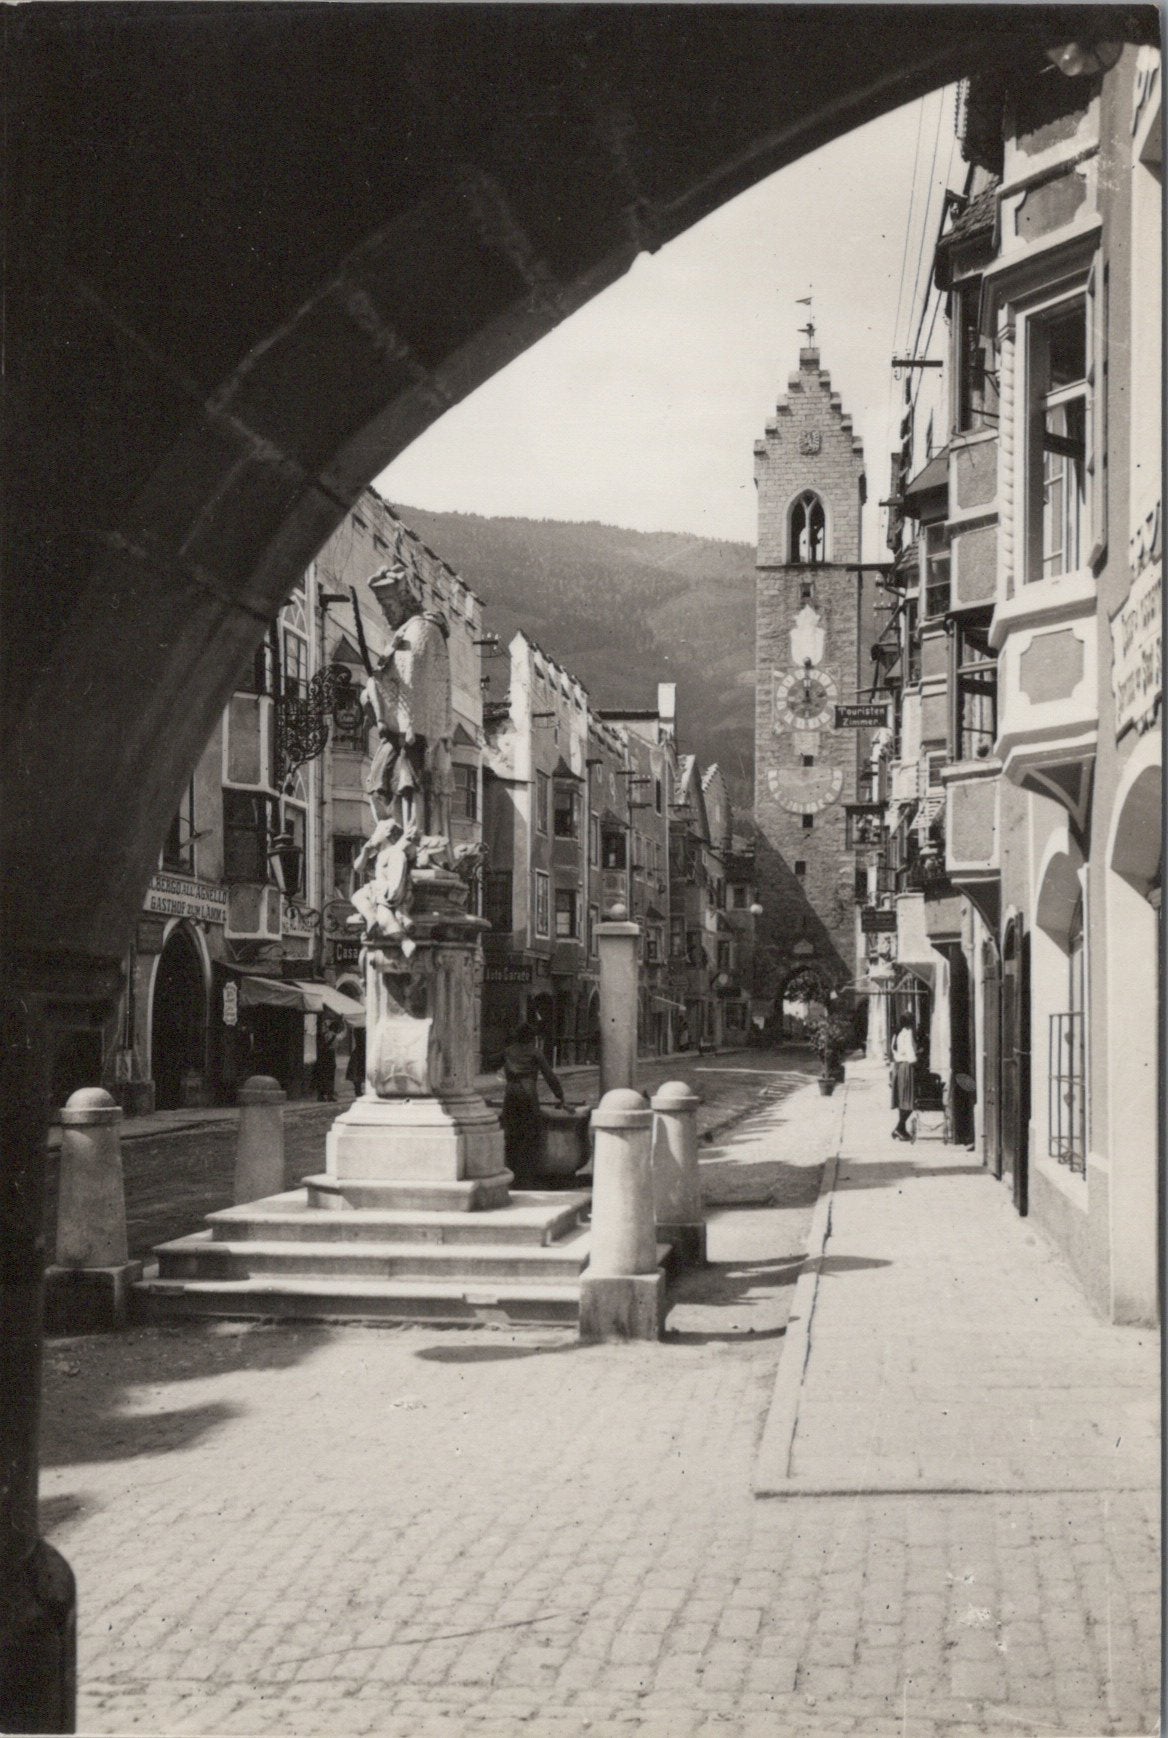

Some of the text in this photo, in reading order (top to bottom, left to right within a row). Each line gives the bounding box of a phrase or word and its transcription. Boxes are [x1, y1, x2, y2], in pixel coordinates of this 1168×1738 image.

[838, 706, 885, 716] Touristen
[150, 895, 186, 915] GASTHOF
[336, 943, 358, 961] Casa
